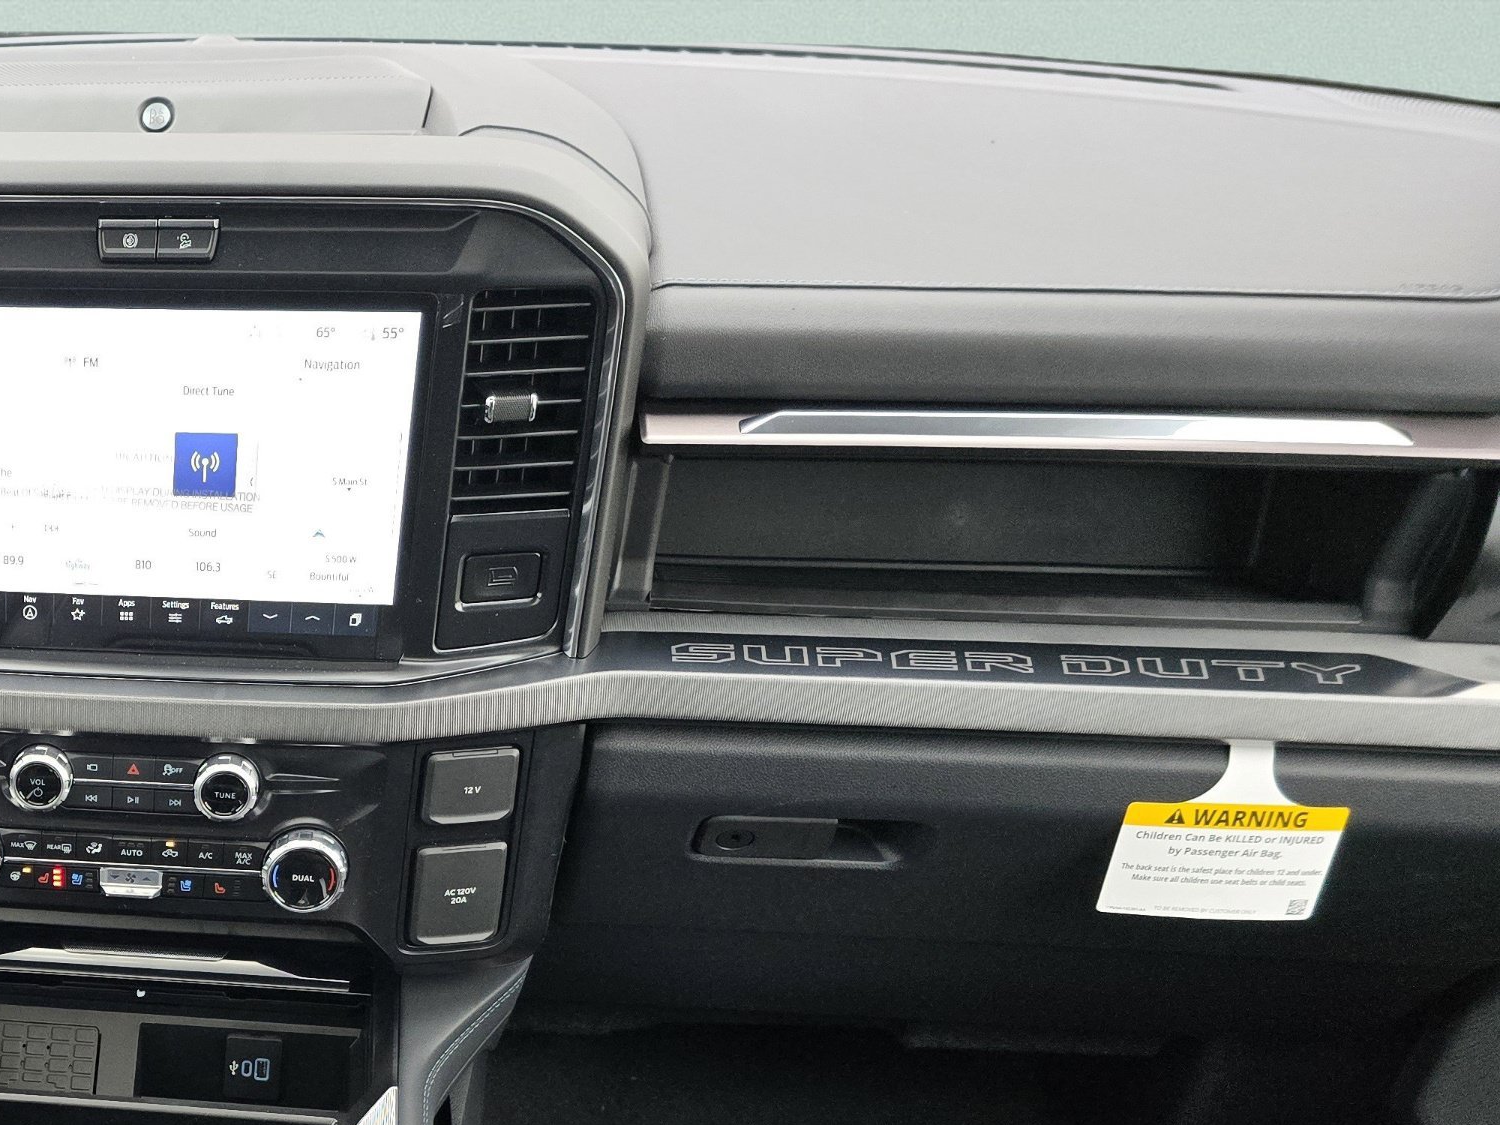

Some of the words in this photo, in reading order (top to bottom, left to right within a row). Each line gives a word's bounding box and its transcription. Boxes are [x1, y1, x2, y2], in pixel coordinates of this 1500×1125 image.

[316, 326, 336, 338] 65°
[382, 326, 404, 340] 55°
[82, 358, 100, 368] FM
[304, 358, 360, 372] Navigation
[182, 386, 210, 396] Direct
[212, 386, 236, 397] Tune
[180, 500, 218, 512] BEFORE
[220, 502, 254, 514] USAGE
[188, 528, 218, 538] Sound
[2, 554, 24, 566] 89.9
[135, 560, 152, 570] 810
[194, 560, 222, 572] 106.3
[308, 572, 350, 582] Bountiful
[23, 594, 38, 604] Nav
[72, 596, 86, 606] Fav
[118, 598, 136, 608] Apps
[161, 600, 190, 610] Settings
[210, 602, 240, 612] Features
[670, 642, 1034, 676] SUPER
[1060, 652, 1362, 686] DUTY
[30, 778, 46, 786] VOL
[463, 786, 474, 795] 12
[474, 785, 482, 794] V
[214, 791, 237, 800] TUNE
[1194, 808, 1310, 828] WARNING
[1134, 830, 1182, 842] Children
[1184, 832, 1208, 843] Can
[1208, 834, 1223, 844] Be
[1224, 834, 1262, 844] KILLED
[1264, 836, 1276, 844] or
[1278, 834, 1326, 846] INJURED
[120, 849, 144, 858] AUTO
[198, 851, 214, 860] A/C
[234, 852, 253, 860] MAX
[1167, 846, 1182, 857] by
[1182, 846, 1241, 859] Passenger
[1242, 848, 1257, 858] Air
[1258, 848, 1284, 860] Bag.
[236, 858, 252, 866] A/C
[1122, 862, 1134, 870] The
[1136, 864, 1152, 872] back
[1178, 865, 1190, 874] the
[1214, 867, 1233, 876] place
[291, 874, 315, 884] DUAL
[1130, 873, 1152, 882] Make
[1169, 876, 1180, 884] all
[1180, 876, 1210, 885] children
[444, 888, 456, 898] AC
[456, 886, 477, 896] 120V
[450, 896, 468, 905] 20A
